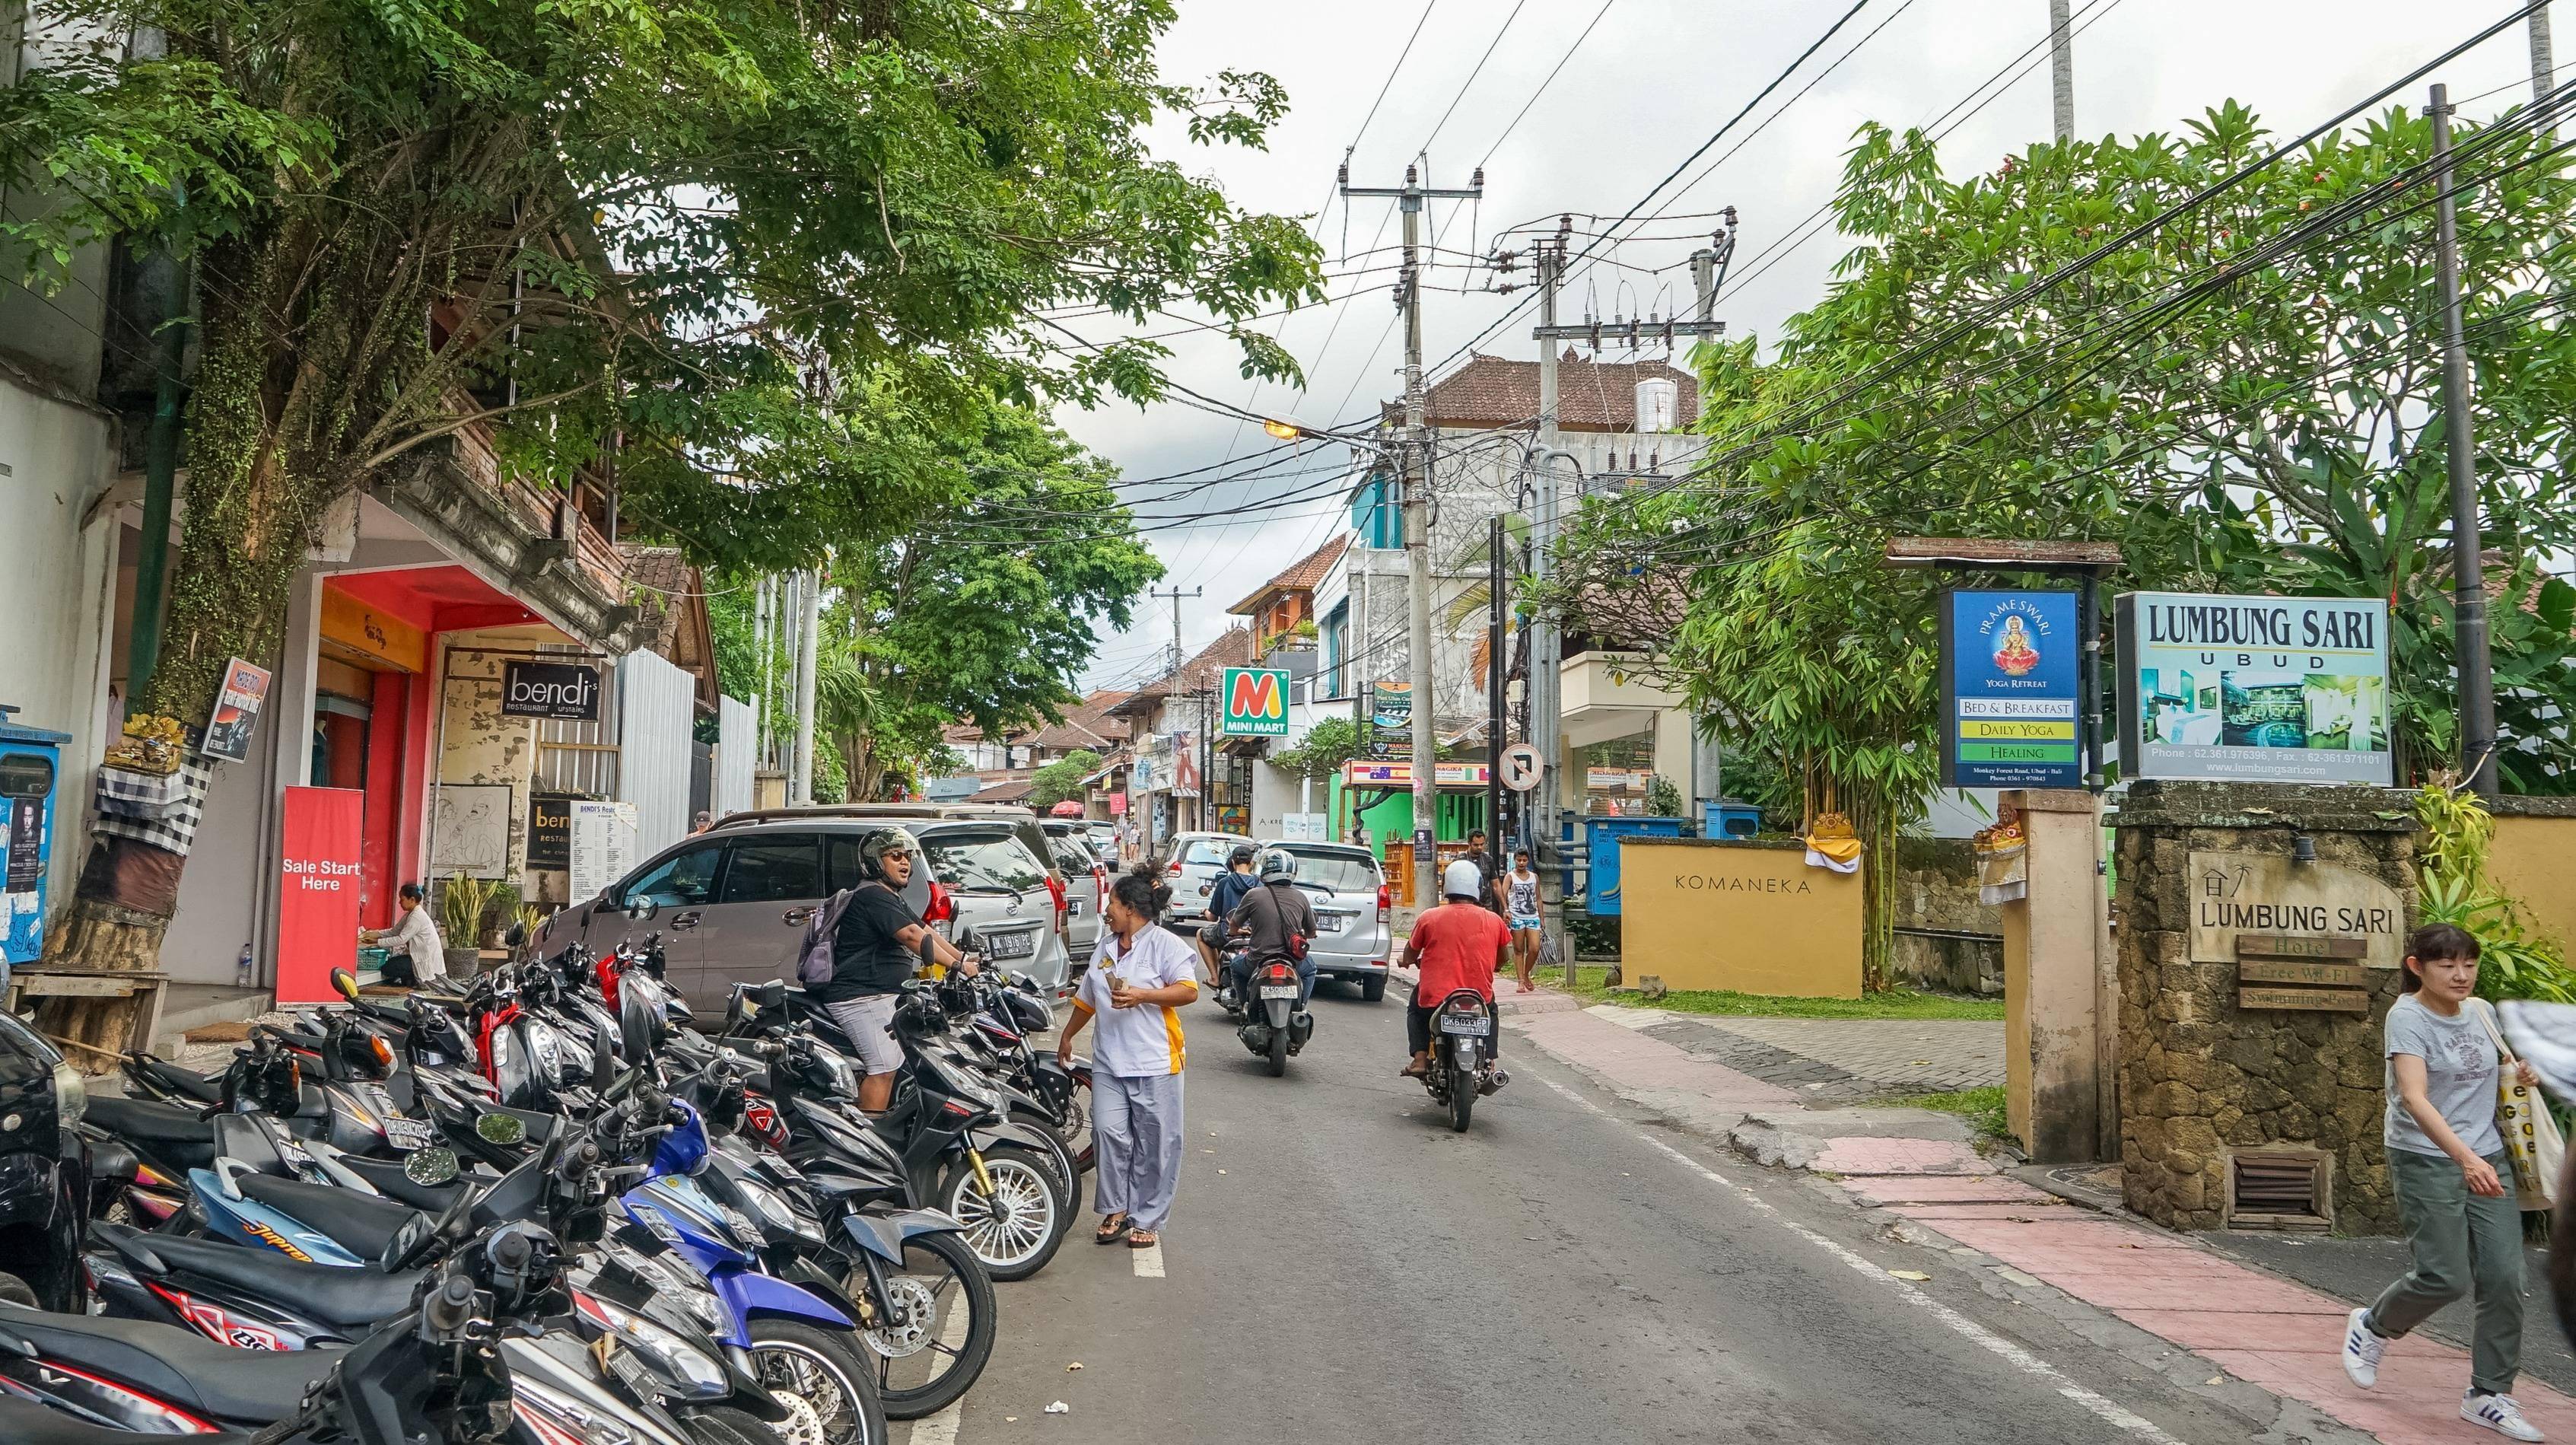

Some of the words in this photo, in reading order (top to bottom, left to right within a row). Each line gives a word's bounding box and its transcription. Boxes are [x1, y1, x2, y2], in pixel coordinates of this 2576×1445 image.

[2148, 605, 2291, 646] LUMBUNG
[2302, 610, 2374, 649] SARI
[2201, 653, 2324, 669] UBUD
[1986, 680, 2008, 689] YOGA
[2012, 680, 2047, 689] RETREAT
[1964, 702, 1986, 714] BED
[1989, 702, 2000, 714] &
[2005, 702, 2070, 715] BREAKFAST
[1226, 721, 1252, 732] MINI
[1254, 722, 1286, 733] MART
[1980, 724, 2015, 736] DAILY
[2021, 724, 2054, 737] YOGA
[1991, 746, 2044, 758] HEALING
[2151, 748, 2185, 759] Phone
[2206, 762, 2326, 775] www.lumbungsari.com
[580, 805, 600, 813] BENDI'S
[283, 859, 316, 874] Sale
[320, 861, 361, 875] Start
[302, 876, 340, 890] Here
[1675, 875, 1811, 894] KOMANEKA
[2202, 902, 2327, 931] LUMBUNG
[2338, 908, 2395, 934] SARI
[992, 937, 1002, 949] DK
[1004, 934, 1019, 948] 1916
[1021, 934, 1030, 946] PC
[2275, 938, 2332, 954] Hotel
